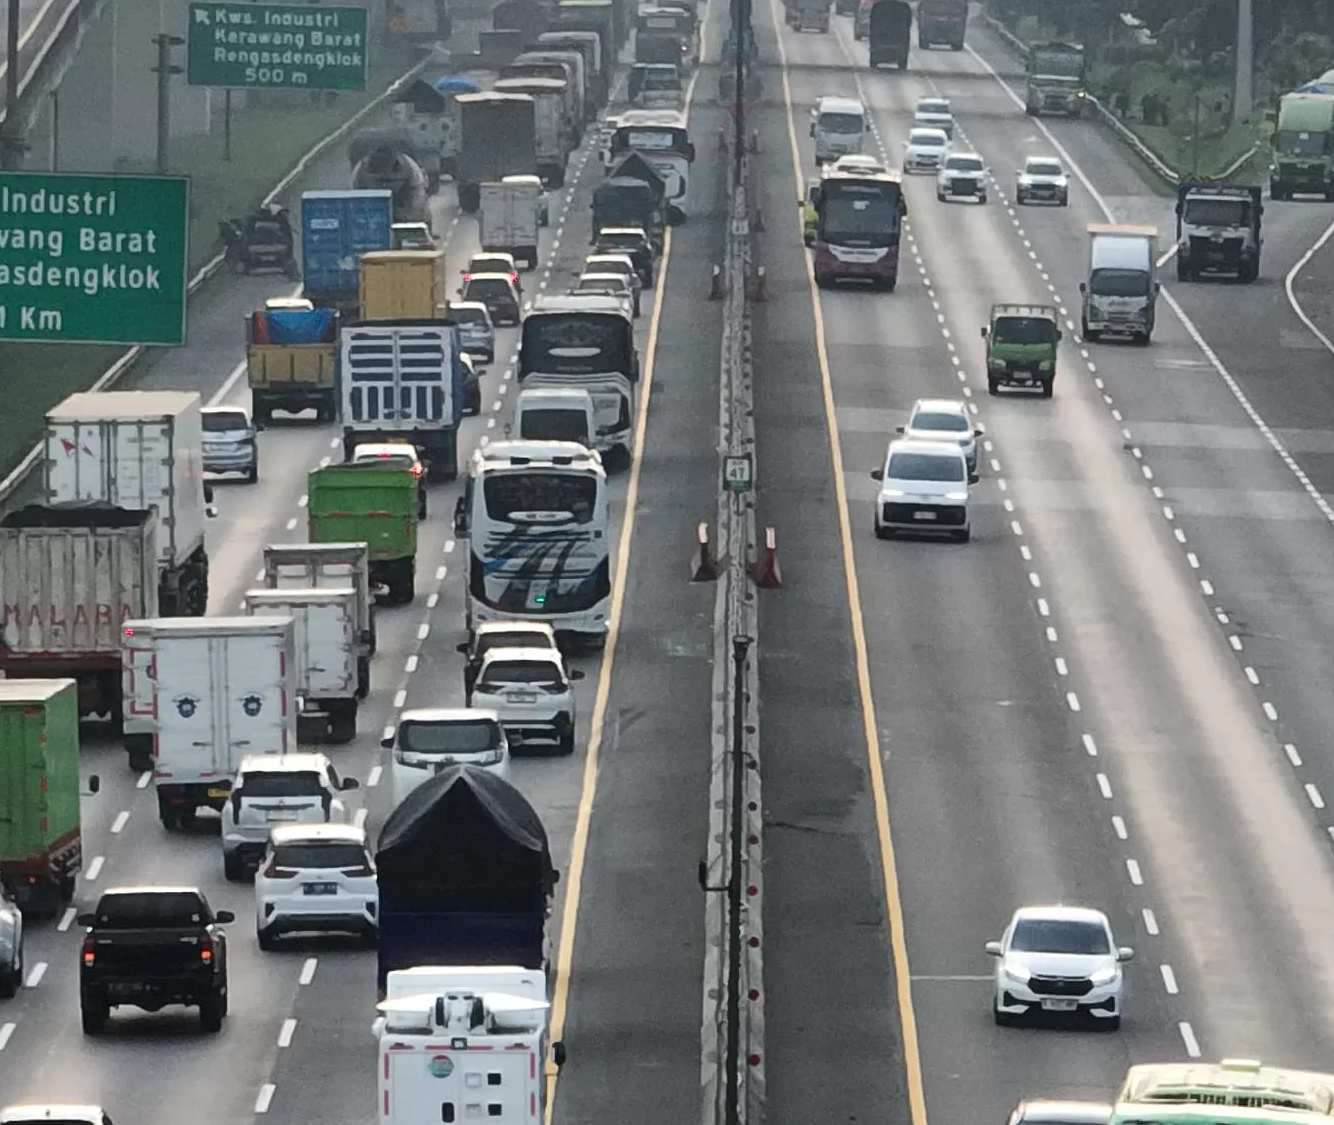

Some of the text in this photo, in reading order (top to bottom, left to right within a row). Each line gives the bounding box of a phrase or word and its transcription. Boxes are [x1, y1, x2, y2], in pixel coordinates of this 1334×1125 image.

[215, 9, 339, 27] Kws. Industri
[214, 28, 362, 49] Karawang Barat
[214, 47, 363, 69] Rengasdengklok
[244, 68, 308, 84] 500 m
[2, 187, 116, 215] Industri
[79, 227, 157, 254] Barat
[20, 306, 62, 331] Km
